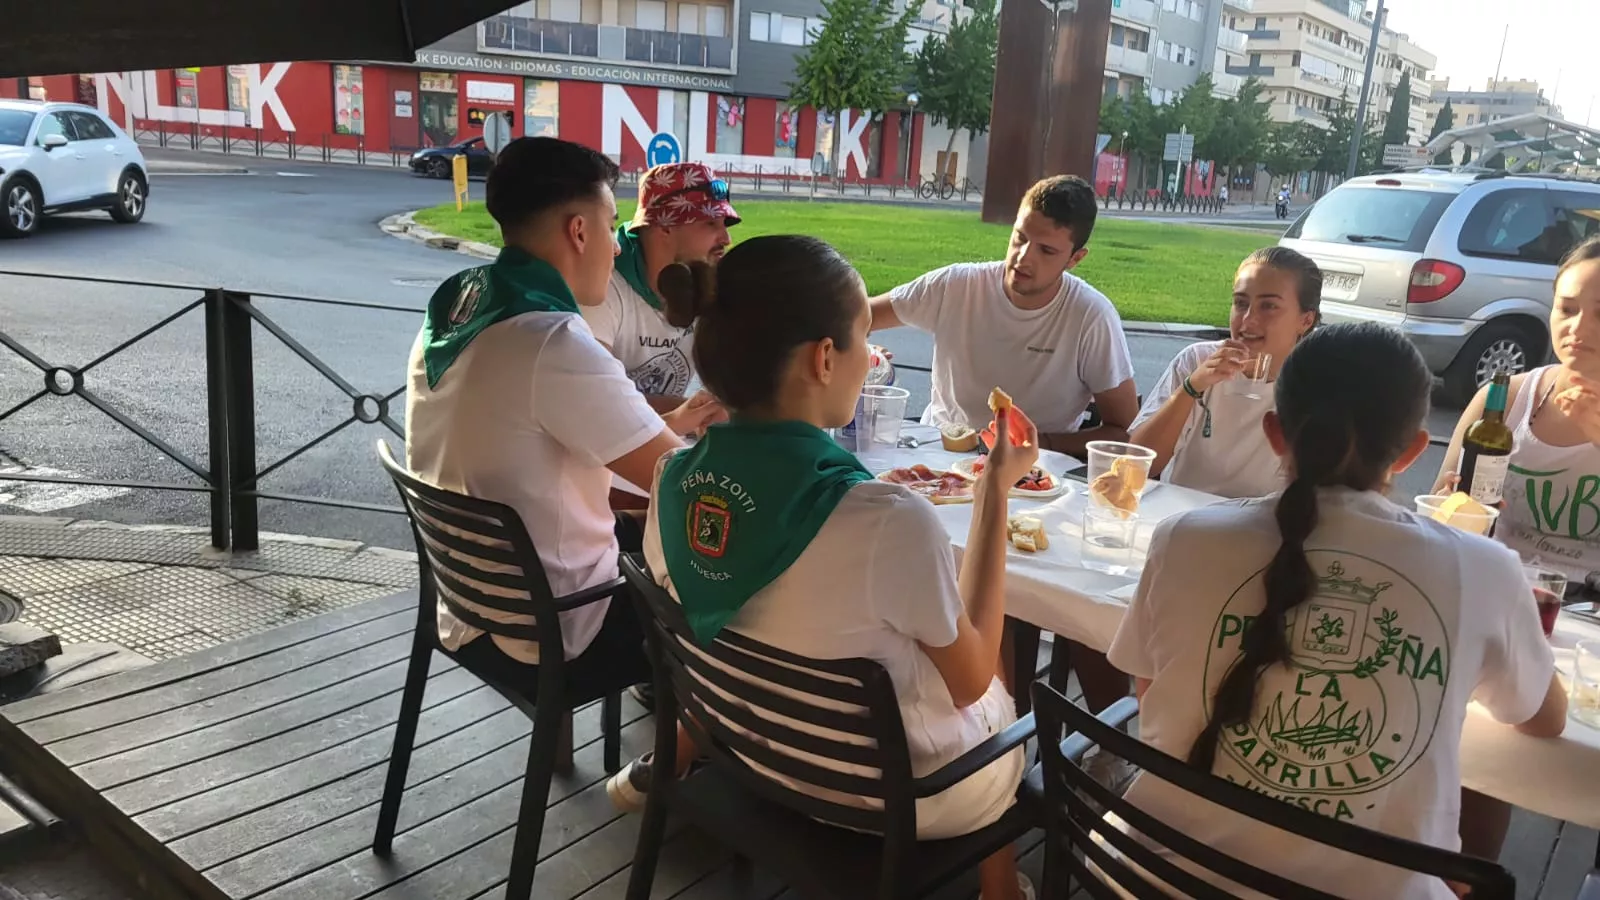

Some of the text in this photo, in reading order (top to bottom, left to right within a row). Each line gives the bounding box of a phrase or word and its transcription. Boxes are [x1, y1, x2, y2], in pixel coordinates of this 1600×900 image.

[432, 54, 503, 70] EDUCATION
[511, 61, 562, 74] IDIOMAS
[571, 65, 641, 81] EDUCACIÓN
[643, 72, 731, 89] INTERNACIONAL
[681, 469, 757, 513] PEÑA ZOITI
[688, 559, 732, 581] HUESCA
[1295, 673, 1342, 702] LA
[1227, 722, 1396, 788] PARRILLA
[1243, 779, 1354, 820] SCA
